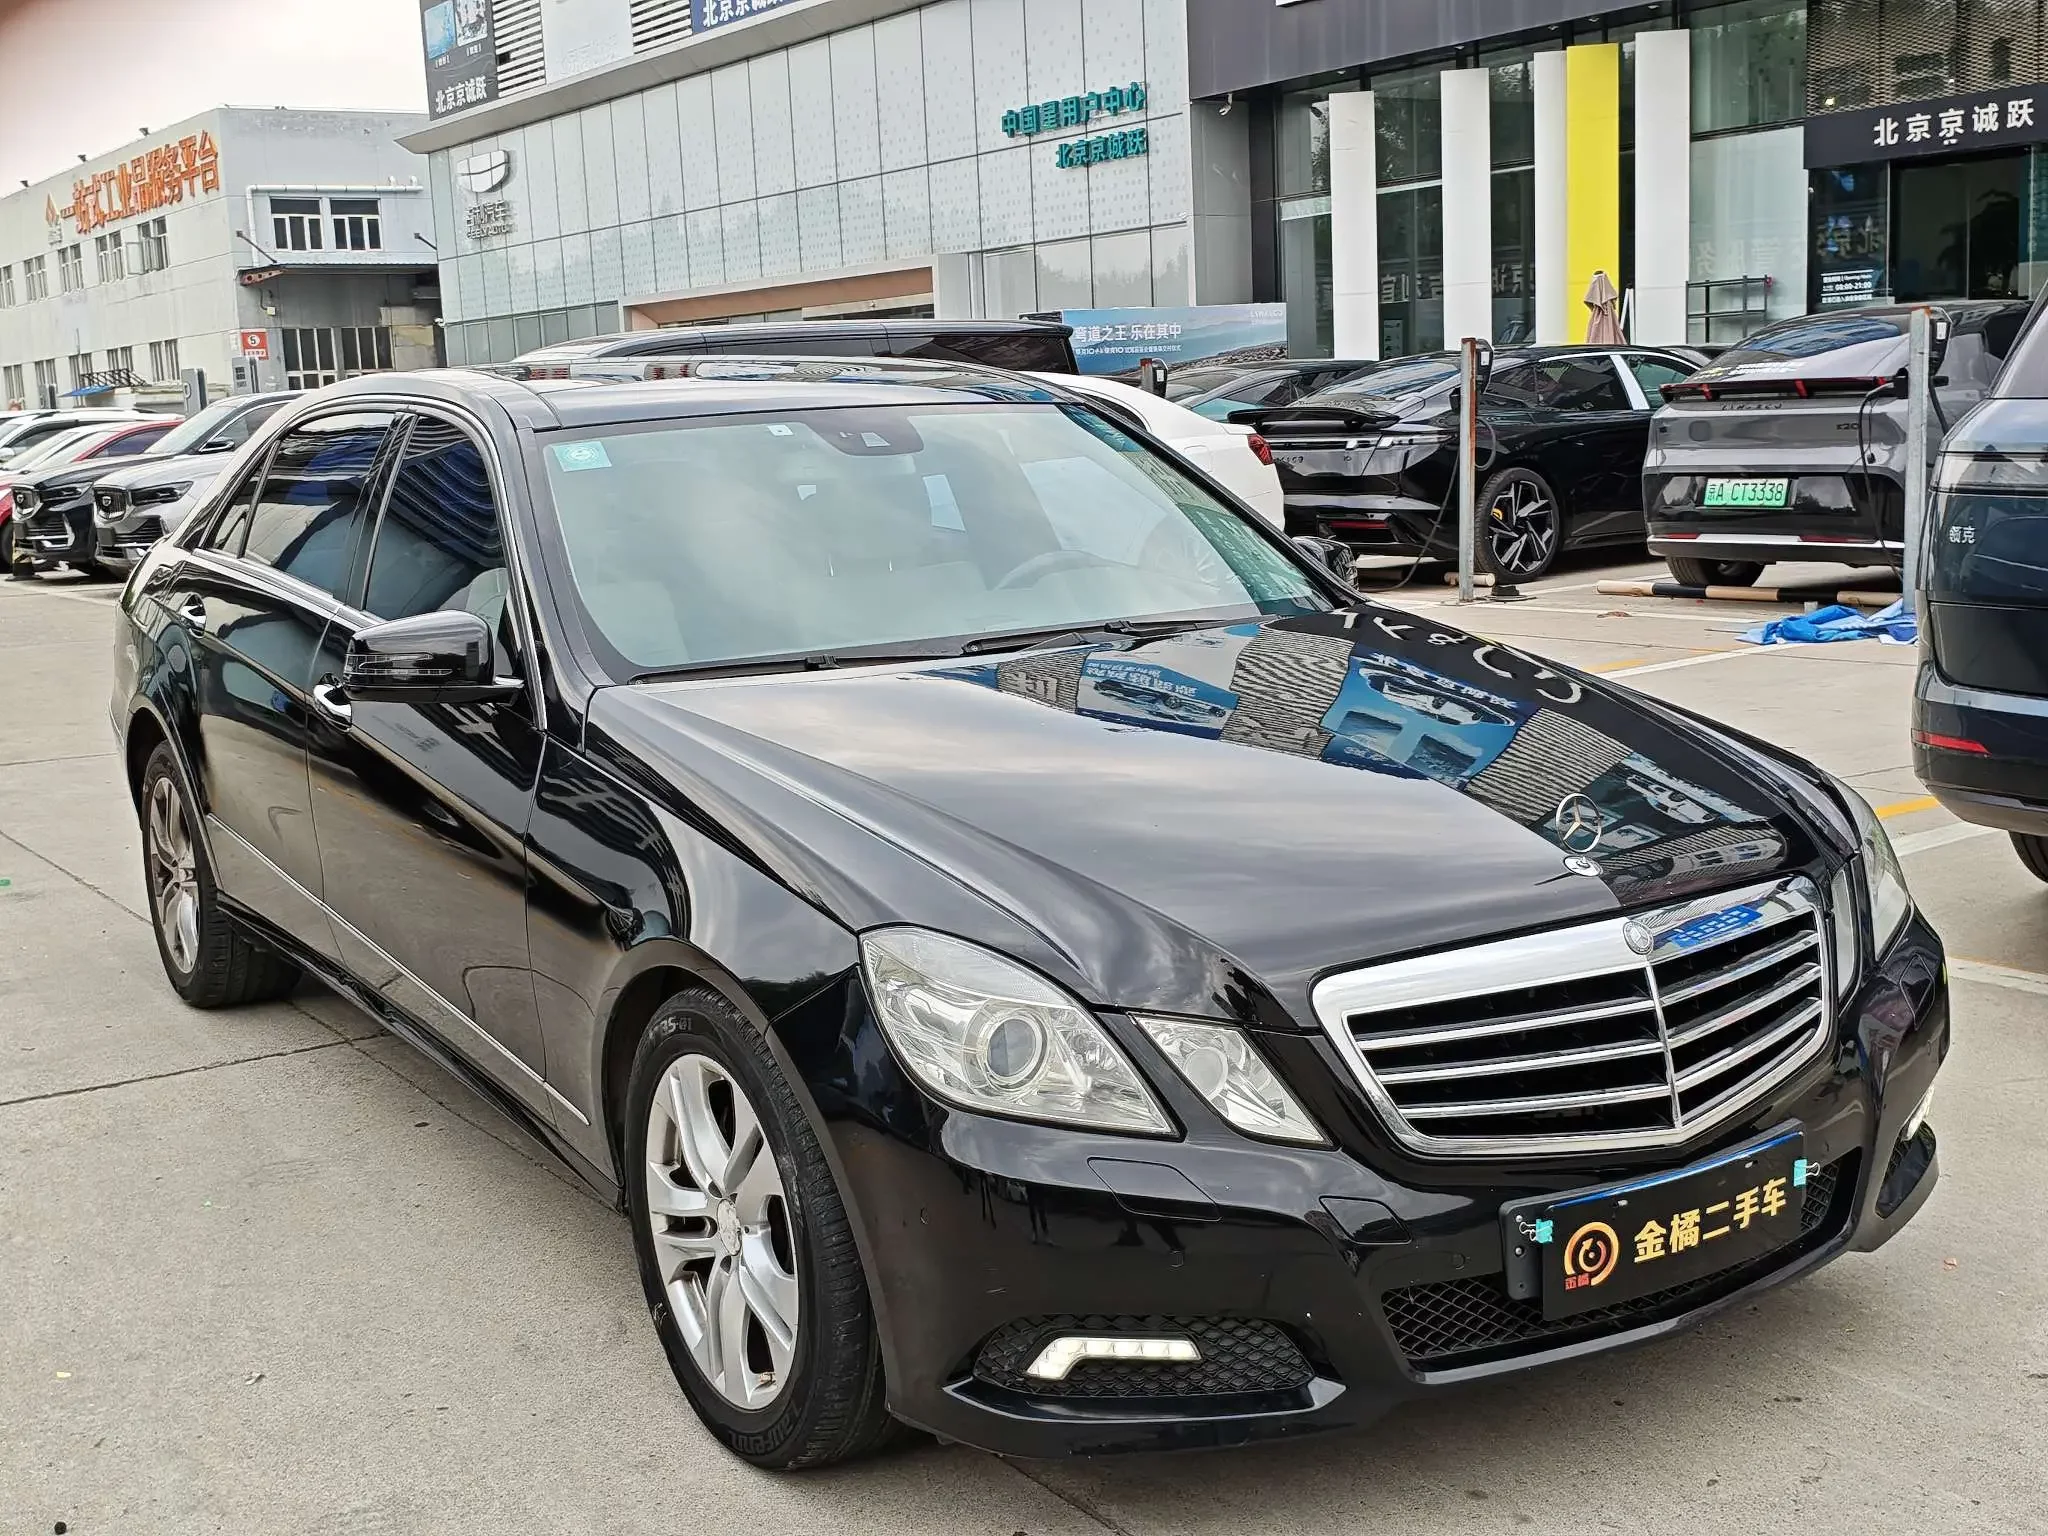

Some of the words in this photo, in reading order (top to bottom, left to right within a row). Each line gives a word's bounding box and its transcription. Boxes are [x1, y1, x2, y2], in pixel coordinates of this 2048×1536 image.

[1873, 98, 2035, 147] 北京京诚跃
[1055, 127, 1148, 169] 北京京诚跃
[1129, 322, 1182, 341] 乐在其中
[1950, 525, 1976, 544] 领克
[1634, 1176, 1787, 1263] 金橘二手车
